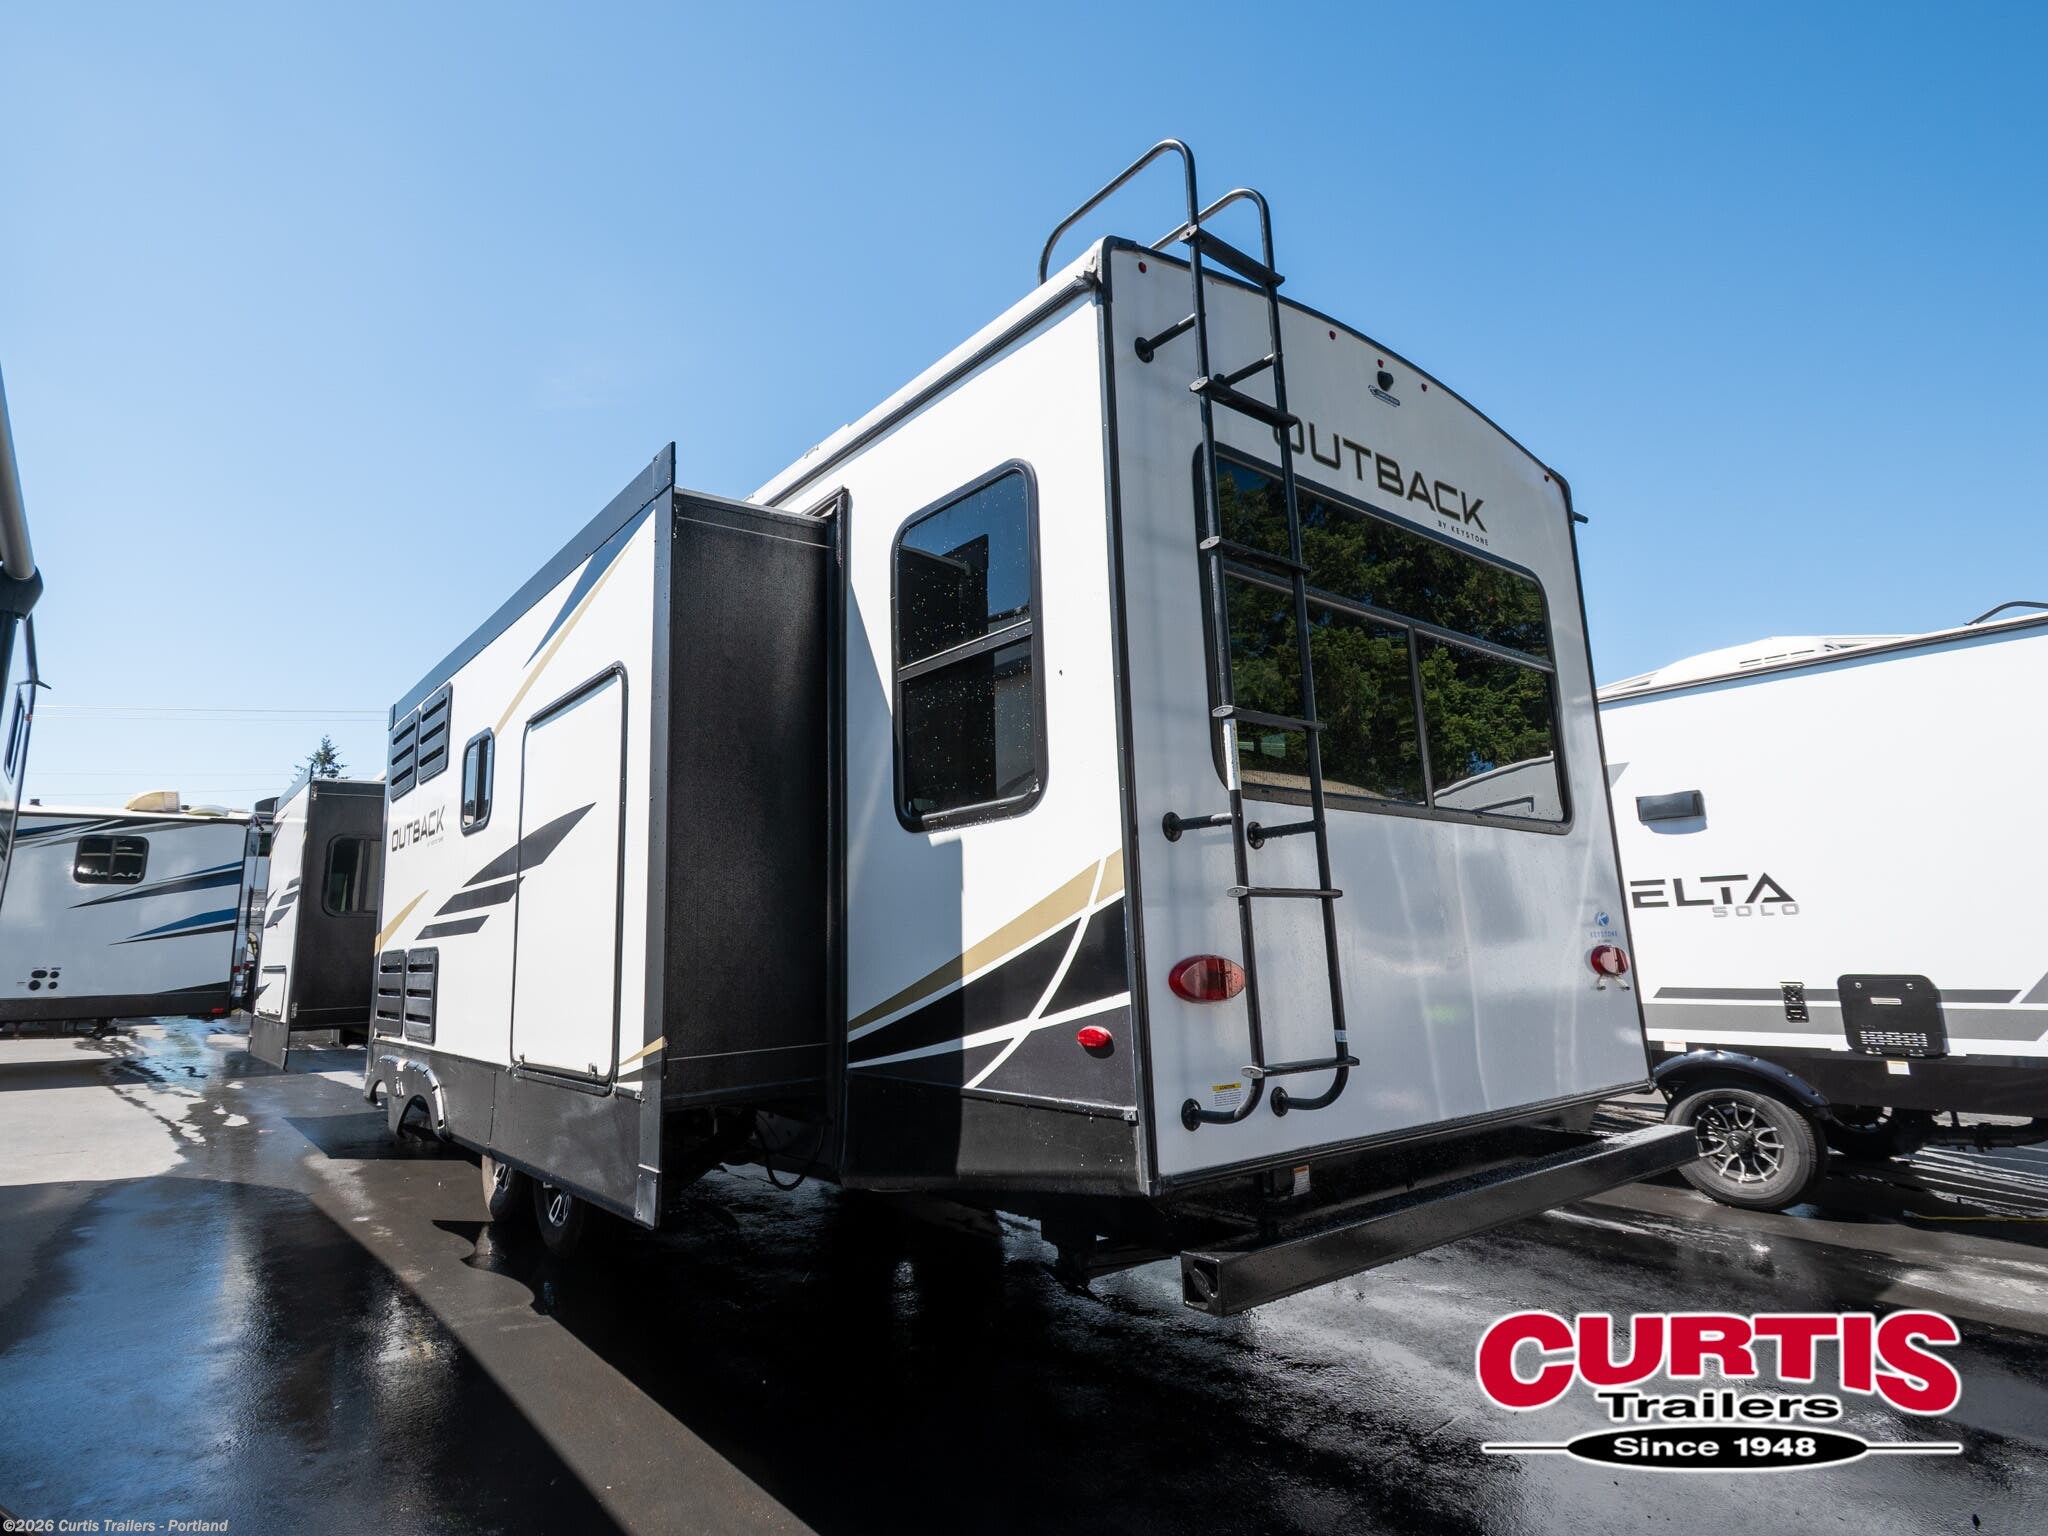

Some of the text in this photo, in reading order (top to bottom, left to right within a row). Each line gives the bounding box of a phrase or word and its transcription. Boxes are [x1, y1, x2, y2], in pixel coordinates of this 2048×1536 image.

[1272, 414, 1488, 533] OUTBACK
[1438, 520, 1488, 546] BY KEYSTONE
[391, 804, 446, 852] OUTBACK
[1712, 903, 1799, 918] SOLO
